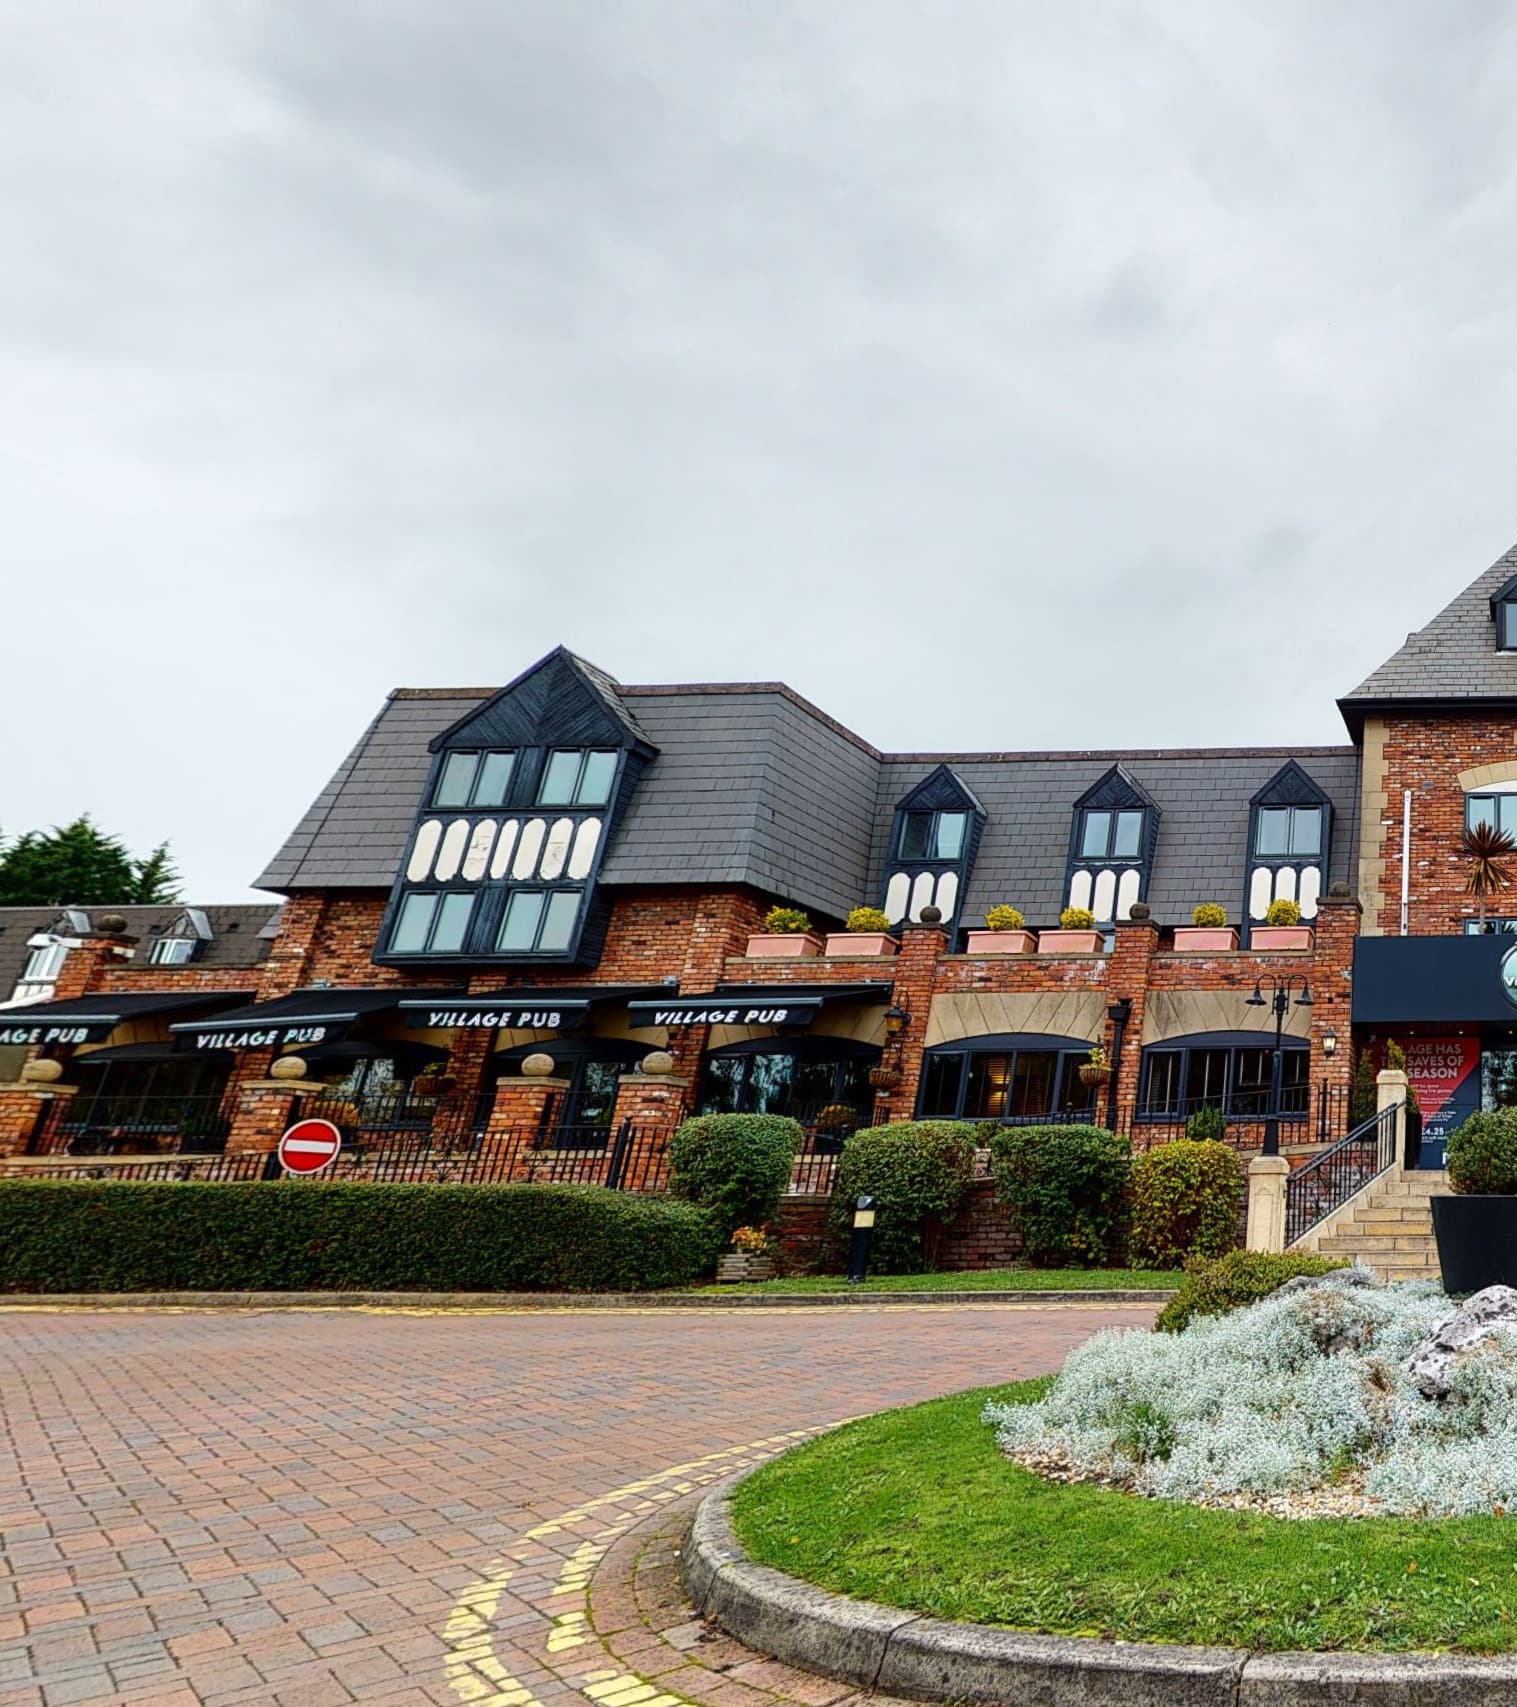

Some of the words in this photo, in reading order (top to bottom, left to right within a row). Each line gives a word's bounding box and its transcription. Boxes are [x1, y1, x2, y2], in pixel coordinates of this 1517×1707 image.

[427, 1012, 512, 1027] VILLAGE
[517, 1012, 560, 1027] PUB
[654, 1010, 738, 1024] VILLAGE
[744, 1009, 788, 1023] PUB
[44, 1027, 89, 1043] PUB
[197, 1030, 278, 1048] VILLAGE
[282, 1027, 326, 1043] PUB
[1436, 1044, 1461, 1054] HAS
[1407, 1056, 1444, 1066] SAVES
[1447, 1056, 1464, 1066] OF
[1407, 1068, 1457, 1079] SEASON
